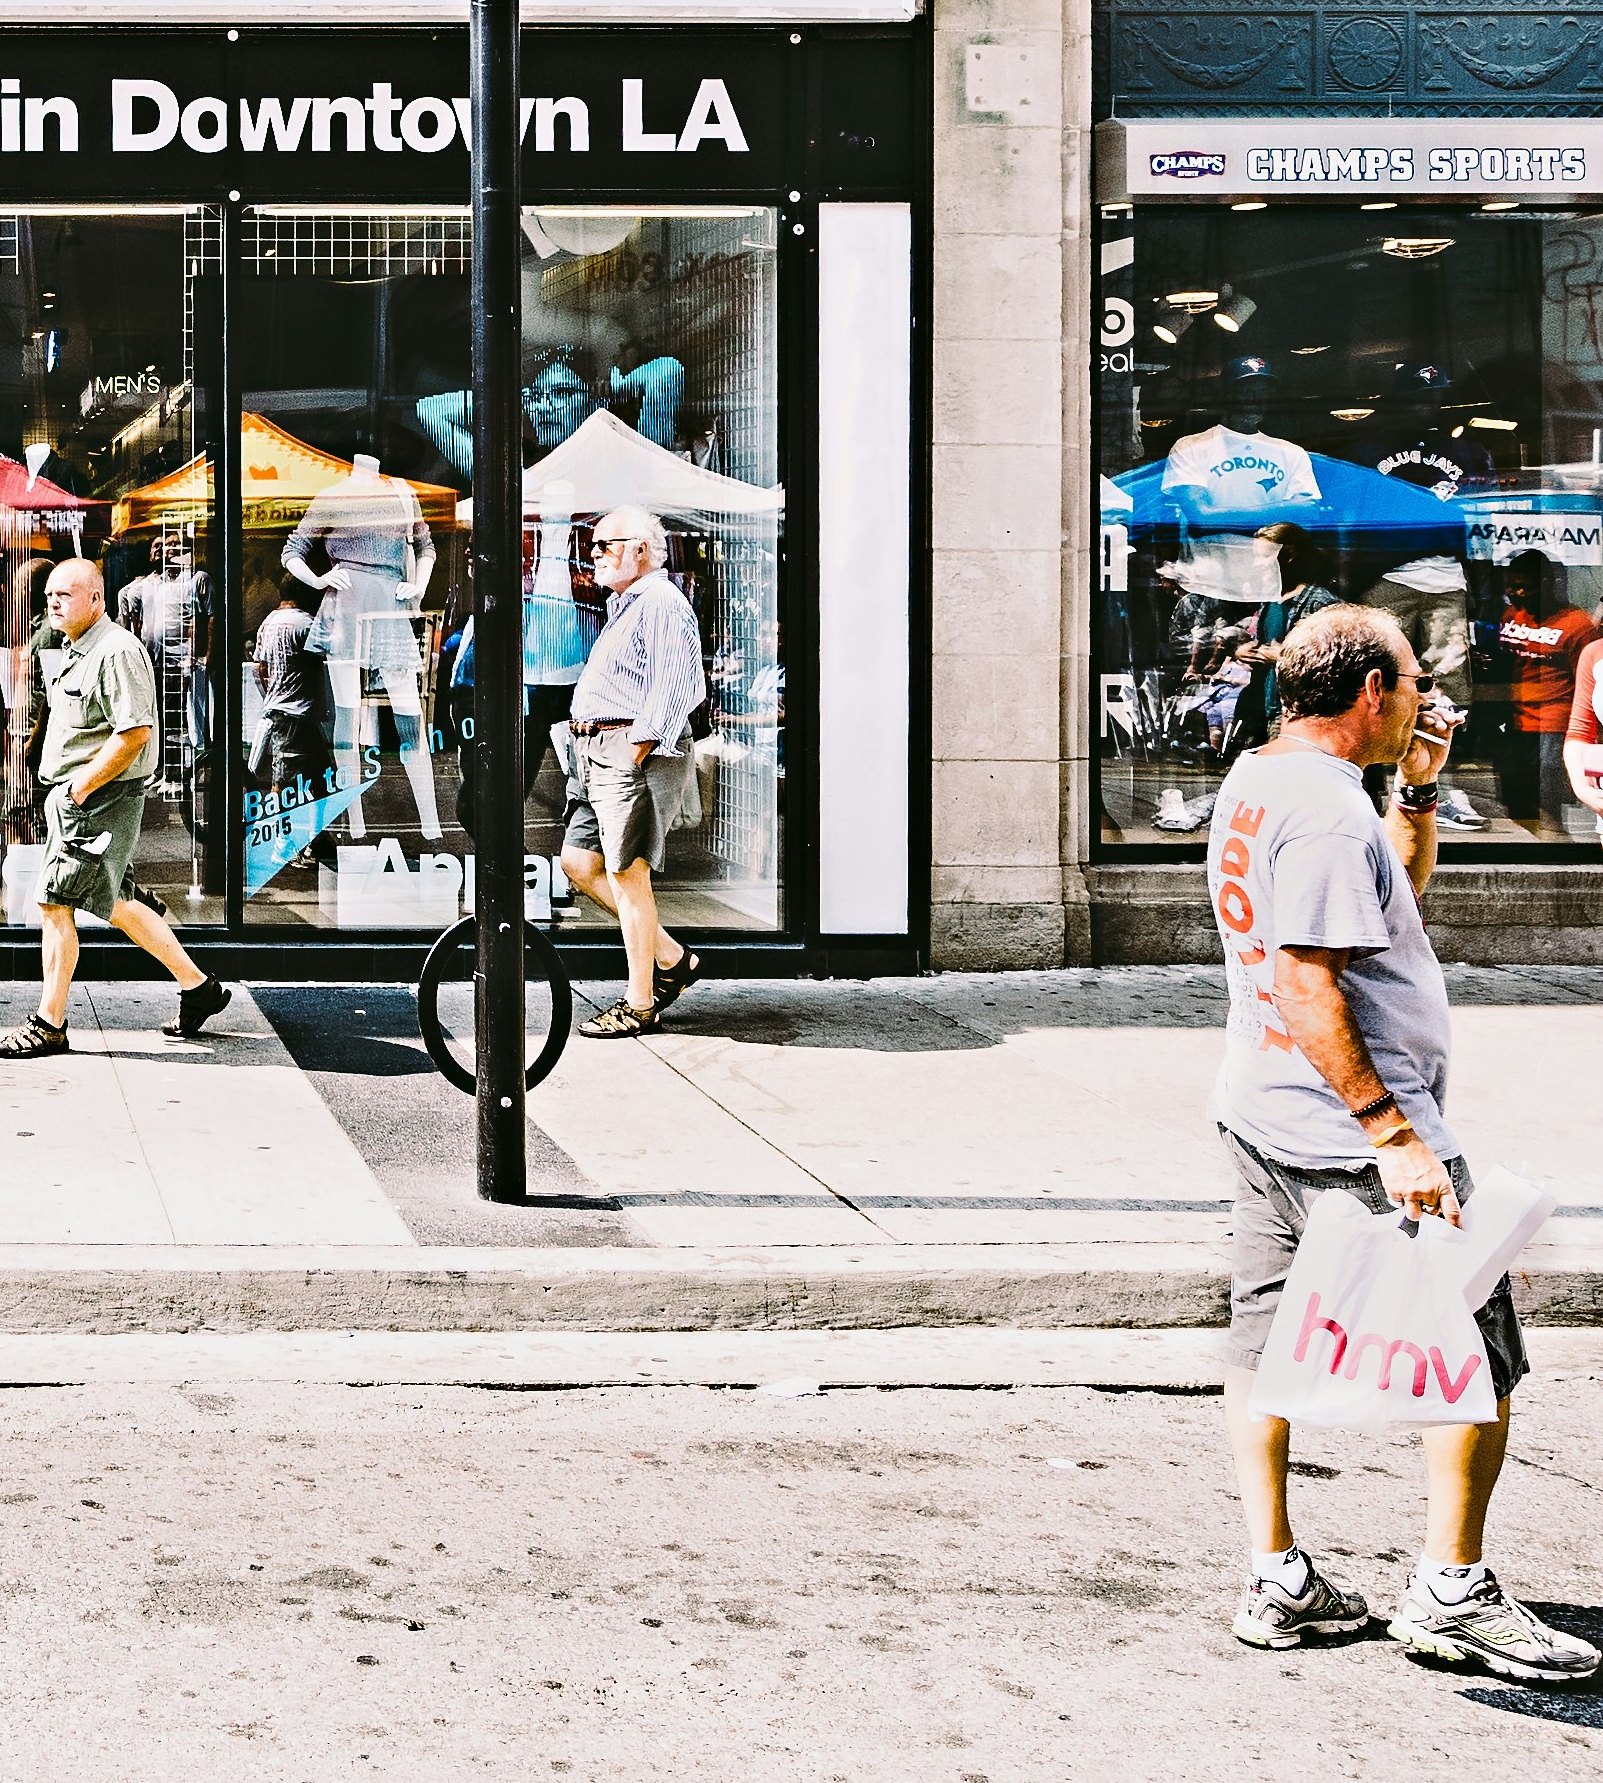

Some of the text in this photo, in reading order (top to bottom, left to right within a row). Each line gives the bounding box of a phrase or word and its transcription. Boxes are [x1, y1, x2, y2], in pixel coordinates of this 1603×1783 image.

[0, 78, 79, 152] in
[622, 79, 750, 152] LA
[1152, 155, 1225, 173] CHAMPS
[1246, 148, 1586, 182] CHAMPS SPORTS
[95, 375, 161, 395] MEN'S
[1210, 455, 1286, 483] TORONTO
[1376, 450, 1464, 480] BLUE JAYS
[244, 773, 314, 823] Back
[323, 764, 353, 790] to
[250, 815, 292, 847] 2015
[1293, 1291, 1482, 1405] hmv
